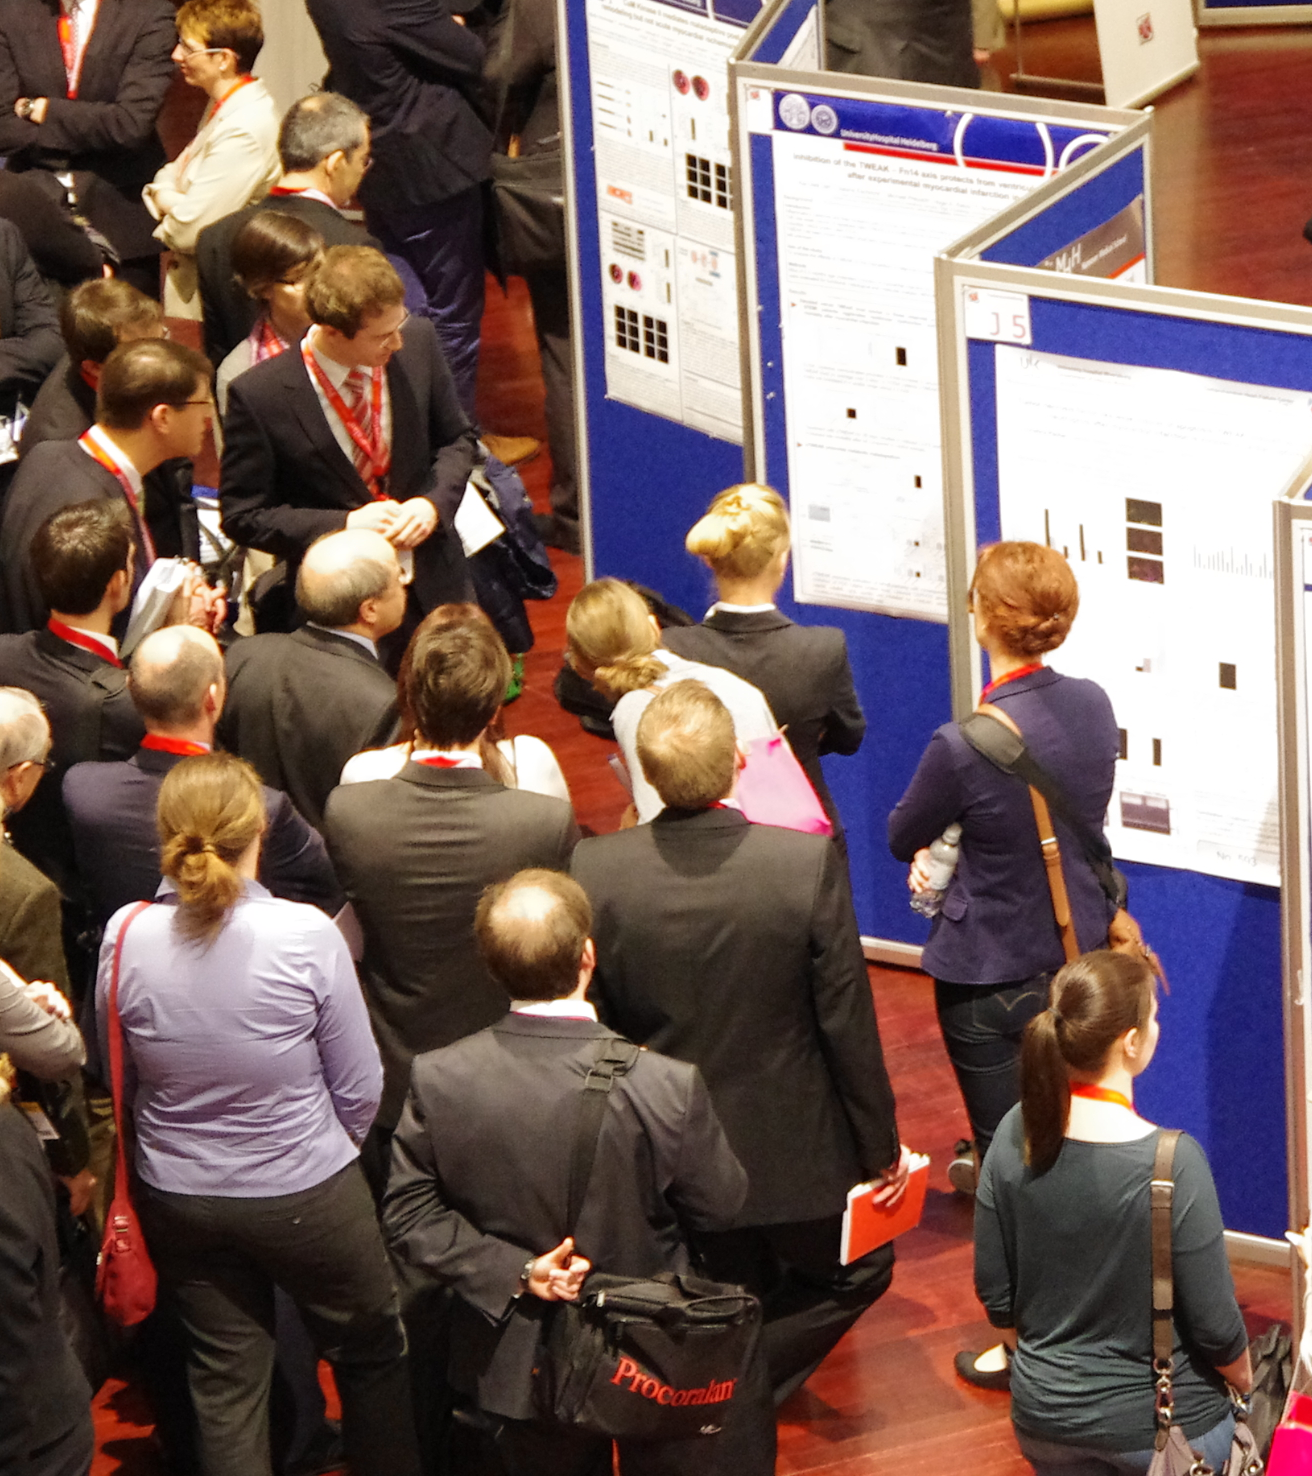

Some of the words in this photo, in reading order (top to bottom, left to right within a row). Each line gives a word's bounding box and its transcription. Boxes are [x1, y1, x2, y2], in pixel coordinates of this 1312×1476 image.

[794, 155, 831, 164] Inhibition
[860, 162, 888, 172] TWEAK
[940, 175, 974, 184] protects
[868, 176, 920, 187] experimental
[923, 184, 968, 194] myocardial
[970, 190, 1009, 199] infarction
[990, 312, 1000, 336] J
[1012, 314, 1026, 338] 5
